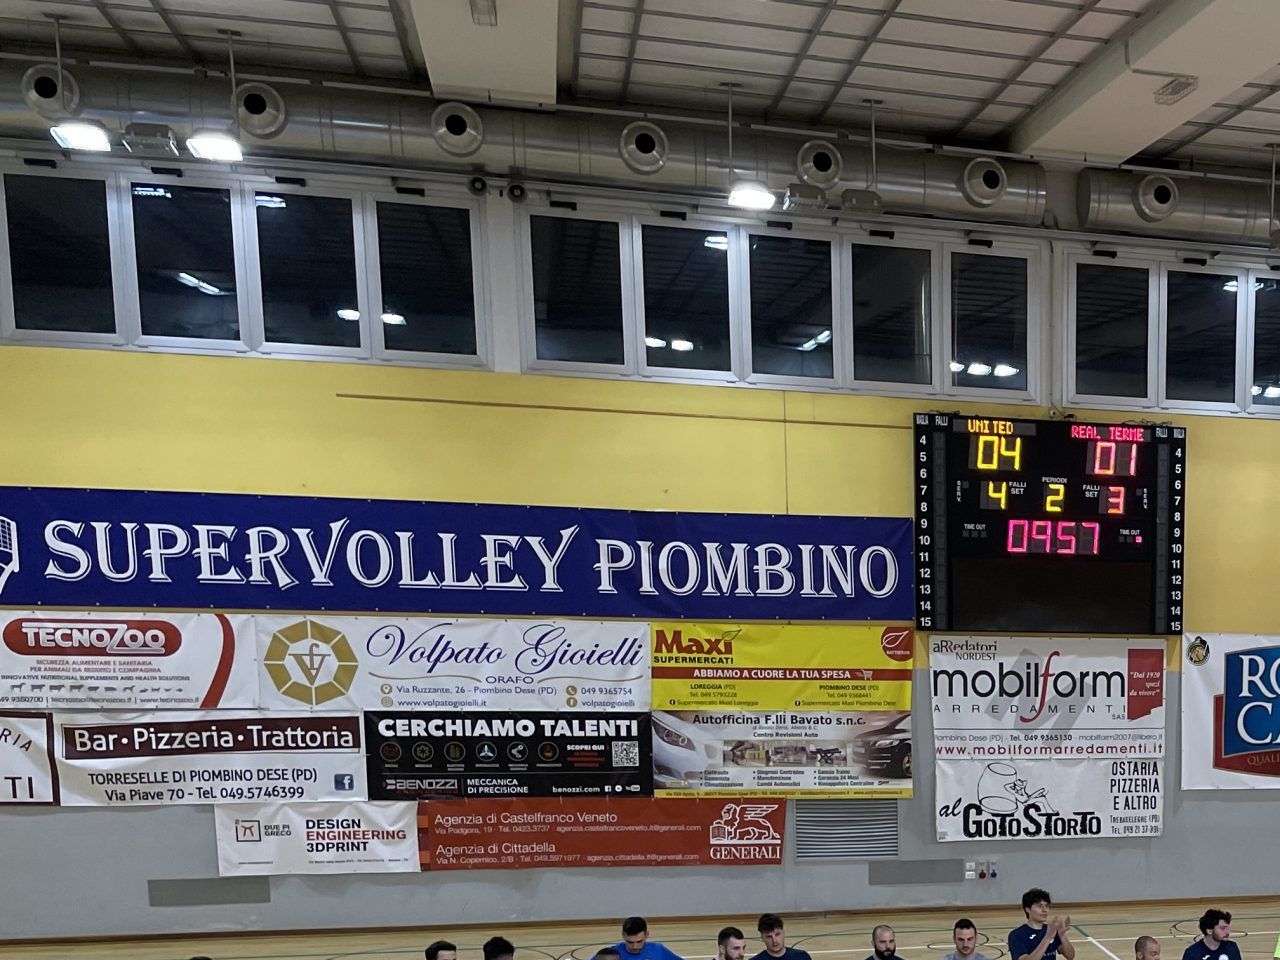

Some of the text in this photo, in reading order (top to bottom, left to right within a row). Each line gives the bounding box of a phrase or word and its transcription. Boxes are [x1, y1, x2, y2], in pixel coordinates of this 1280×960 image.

[967, 419, 1014, 435] UNITED
[1071, 425, 1145, 442] REAL TERME
[920, 435, 926, 445] 4
[920, 452, 927, 462] 5
[977, 435, 1021, 471] 04
[1175, 448, 1182, 458] 4
[1094, 442, 1137, 476] 01
[920, 469, 927, 479] 6
[1175, 464, 1182, 474] 5
[920, 485, 927, 495] 7
[1175, 480, 1182, 490] 6
[988, 480, 1007, 509] 4
[1046, 483, 1065, 512] 2
[1107, 486, 1125, 514] 3
[1174, 496, 1181, 506] 7
[921, 502, 928, 512] 8
[1174, 512, 1181, 522] 8
[921, 519, 928, 529] 9
[1007, 519, 1100, 555] 0957
[1174, 528, 1181, 538] 9
[920, 535, 930, 545] 10
[1172, 544, 1182, 554] 10
[44, 517, 899, 598] SUPERVOLLEY PIOMBINO
[920, 552, 929, 562] 11
[1172, 560, 1181, 569] 11
[920, 568, 931, 578] 12
[1171, 576, 1182, 585] 12
[920, 585, 931, 595] 13
[1171, 591, 1181, 600] 13
[920, 601, 931, 611] 14
[1171, 606, 1181, 616] 14
[920, 617, 931, 627] 15
[1170, 622, 1181, 631] 15
[22, 622, 166, 654] TECNOZOO
[655, 628, 742, 656] Maxi
[366, 623, 644, 675] Volpato Gioielli
[653, 656, 734, 665] SUPERMERCATI
[955, 652, 998, 661] NORDEST
[693, 669, 851, 679] ABBIAMO A CUORE LA TUA SPESA
[485, 675, 534, 685] ORAFO
[396, 685, 410, 694] Via
[455, 686, 466, 695] 26
[473, 685, 513, 695] Piombino
[514, 686, 536, 695] Dese
[537, 686, 557, 696] (PD)
[580, 687, 633, 696] 049 9365754
[933, 651, 1126, 723] mobilform
[397, 698, 487, 709] www.volpatogioielli.it
[581, 699, 636, 709] volpatogioielli
[934, 704, 1126, 714] ARREDAMENTI
[692, 714, 761, 726] Autofficina
[790, 714, 833, 725] Bavato
[377, 718, 639, 737] CERCHIAMO TALENTI
[74, 725, 354, 752] Bar Pizzeria Trattoria
[1024, 734, 1039, 742] 049
[1040, 734, 1073, 742] 9365130
[935, 743, 1163, 756] www.mobilformarredamenti.it
[1111, 761, 1159, 776] OSTARIA
[88, 767, 318, 786] TORRESELLE DI PIOMBINO DESE (PD)
[467, 786, 477, 794] DI
[479, 786, 529, 794] PRECISIONE
[552, 785, 601, 793] benozzi.com
[1110, 778, 1160, 793] PIZZERIA
[105, 786, 305, 802] Via Piave 70 049.5746399
[1113, 795, 1157, 810] E ALTRO
[306, 818, 361, 830] DESIGN
[434, 811, 618, 828] Agenzia di Castelfranco Veneto
[306, 830, 407, 841] ENGINEERING
[306, 841, 369, 853] 3DPRINT
[436, 842, 556, 858] Agenzia di Cittadella
[710, 846, 781, 860] GENERALI
